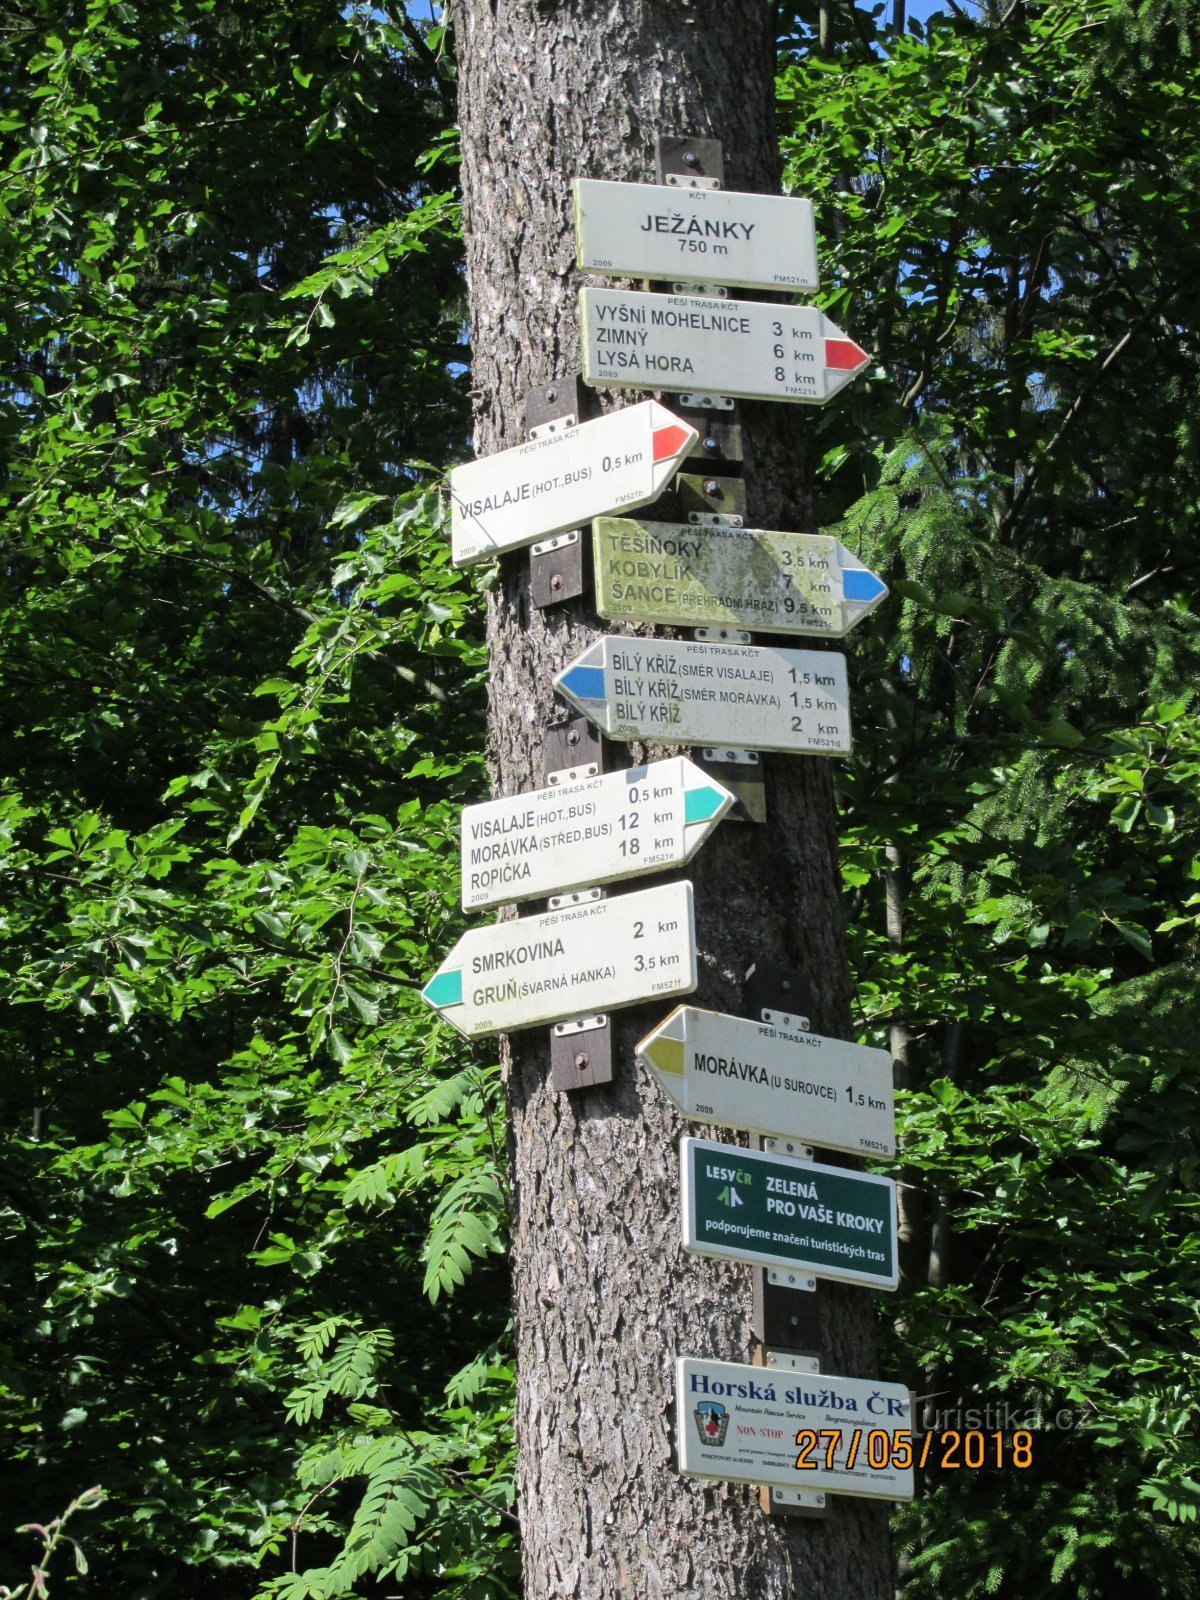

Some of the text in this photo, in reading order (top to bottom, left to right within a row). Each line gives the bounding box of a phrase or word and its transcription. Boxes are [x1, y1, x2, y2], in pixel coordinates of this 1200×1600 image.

[641, 213, 755, 240] JEŽÁNKY
[678, 239, 728, 254] 750 m
[774, 275, 808, 284] FM521m
[690, 300, 719, 310] TRASA
[595, 303, 812, 340] VYŠNÍ MOHELNICE 3 km
[597, 327, 814, 362] ZIMNÝ 6 km
[597, 350, 816, 385] LYSÁ HORA 8 km
[599, 370, 618, 378] 2009
[785, 387, 817, 396] FM521a
[539, 435, 563, 449] TRASA
[459, 483, 531, 520] VISALAJE
[602, 456, 621, 472] 0,5
[625, 452, 643, 466] km
[459, 546, 476, 557] 2009
[608, 534, 830, 568] TĚŠÍŇOKY 3,5 km
[609, 559, 831, 592] KOBYLÍK 7 km
[612, 582, 676, 604] ŠANCE
[784, 598, 808, 615] 9,5
[812, 603, 832, 616] km
[709, 647, 739, 656] TRASA
[612, 653, 642, 672] BÍLÝ
[646, 656, 677, 674] KŘÍŽ
[718, 668, 774, 684] VISALAJE)
[788, 668, 809, 686] 1,5
[814, 673, 835, 686] km
[615, 678, 643, 697] BÍLÝ
[648, 681, 678, 699] KŘÍŽ
[720, 691, 781, 707] MORÁVKA)
[789, 692, 812, 709] 1,5
[816, 699, 837, 711] km
[616, 702, 839, 735] BÍLÝ KŘÍŽ 2 km
[618, 725, 638, 733] 2009
[557, 784, 585, 798] TRASA
[471, 810, 535, 840] VISALAJE
[629, 787, 649, 804] 0,5
[653, 786, 673, 799] km
[471, 834, 538, 866] MORÁVKA
[619, 813, 639, 831] 12
[654, 811, 673, 824] km
[471, 837, 674, 890] ROPIČKA 18 km
[471, 893, 489, 903] 2009
[561, 910, 589, 923] TRASA
[472, 919, 678, 974] SMRKOVINA 2 km
[473, 979, 516, 1006] GRUŇ
[571, 966, 616, 985] HANKA)
[634, 954, 655, 972] 3,5
[660, 954, 680, 967] km
[474, 1020, 492, 1030] 2009
[779, 1032, 805, 1044] TRASA
[694, 1053, 886, 1111] MORÁVKA (U SUROVCE) 1,5 km
[696, 1104, 714, 1114] 2009
[766, 1176, 818, 1200] ZELENÁ
[767, 1198, 884, 1234] PRO VAŠE KROKY
[706, 1219, 885, 1262] podporujeme značení turistických tras
[689, 1374, 906, 1417] Horská služba ČR
[735, 1405, 762, 1414] Mountain
[786, 1411, 806, 1420] Service
[737, 1425, 784, 1439] NON STOP
